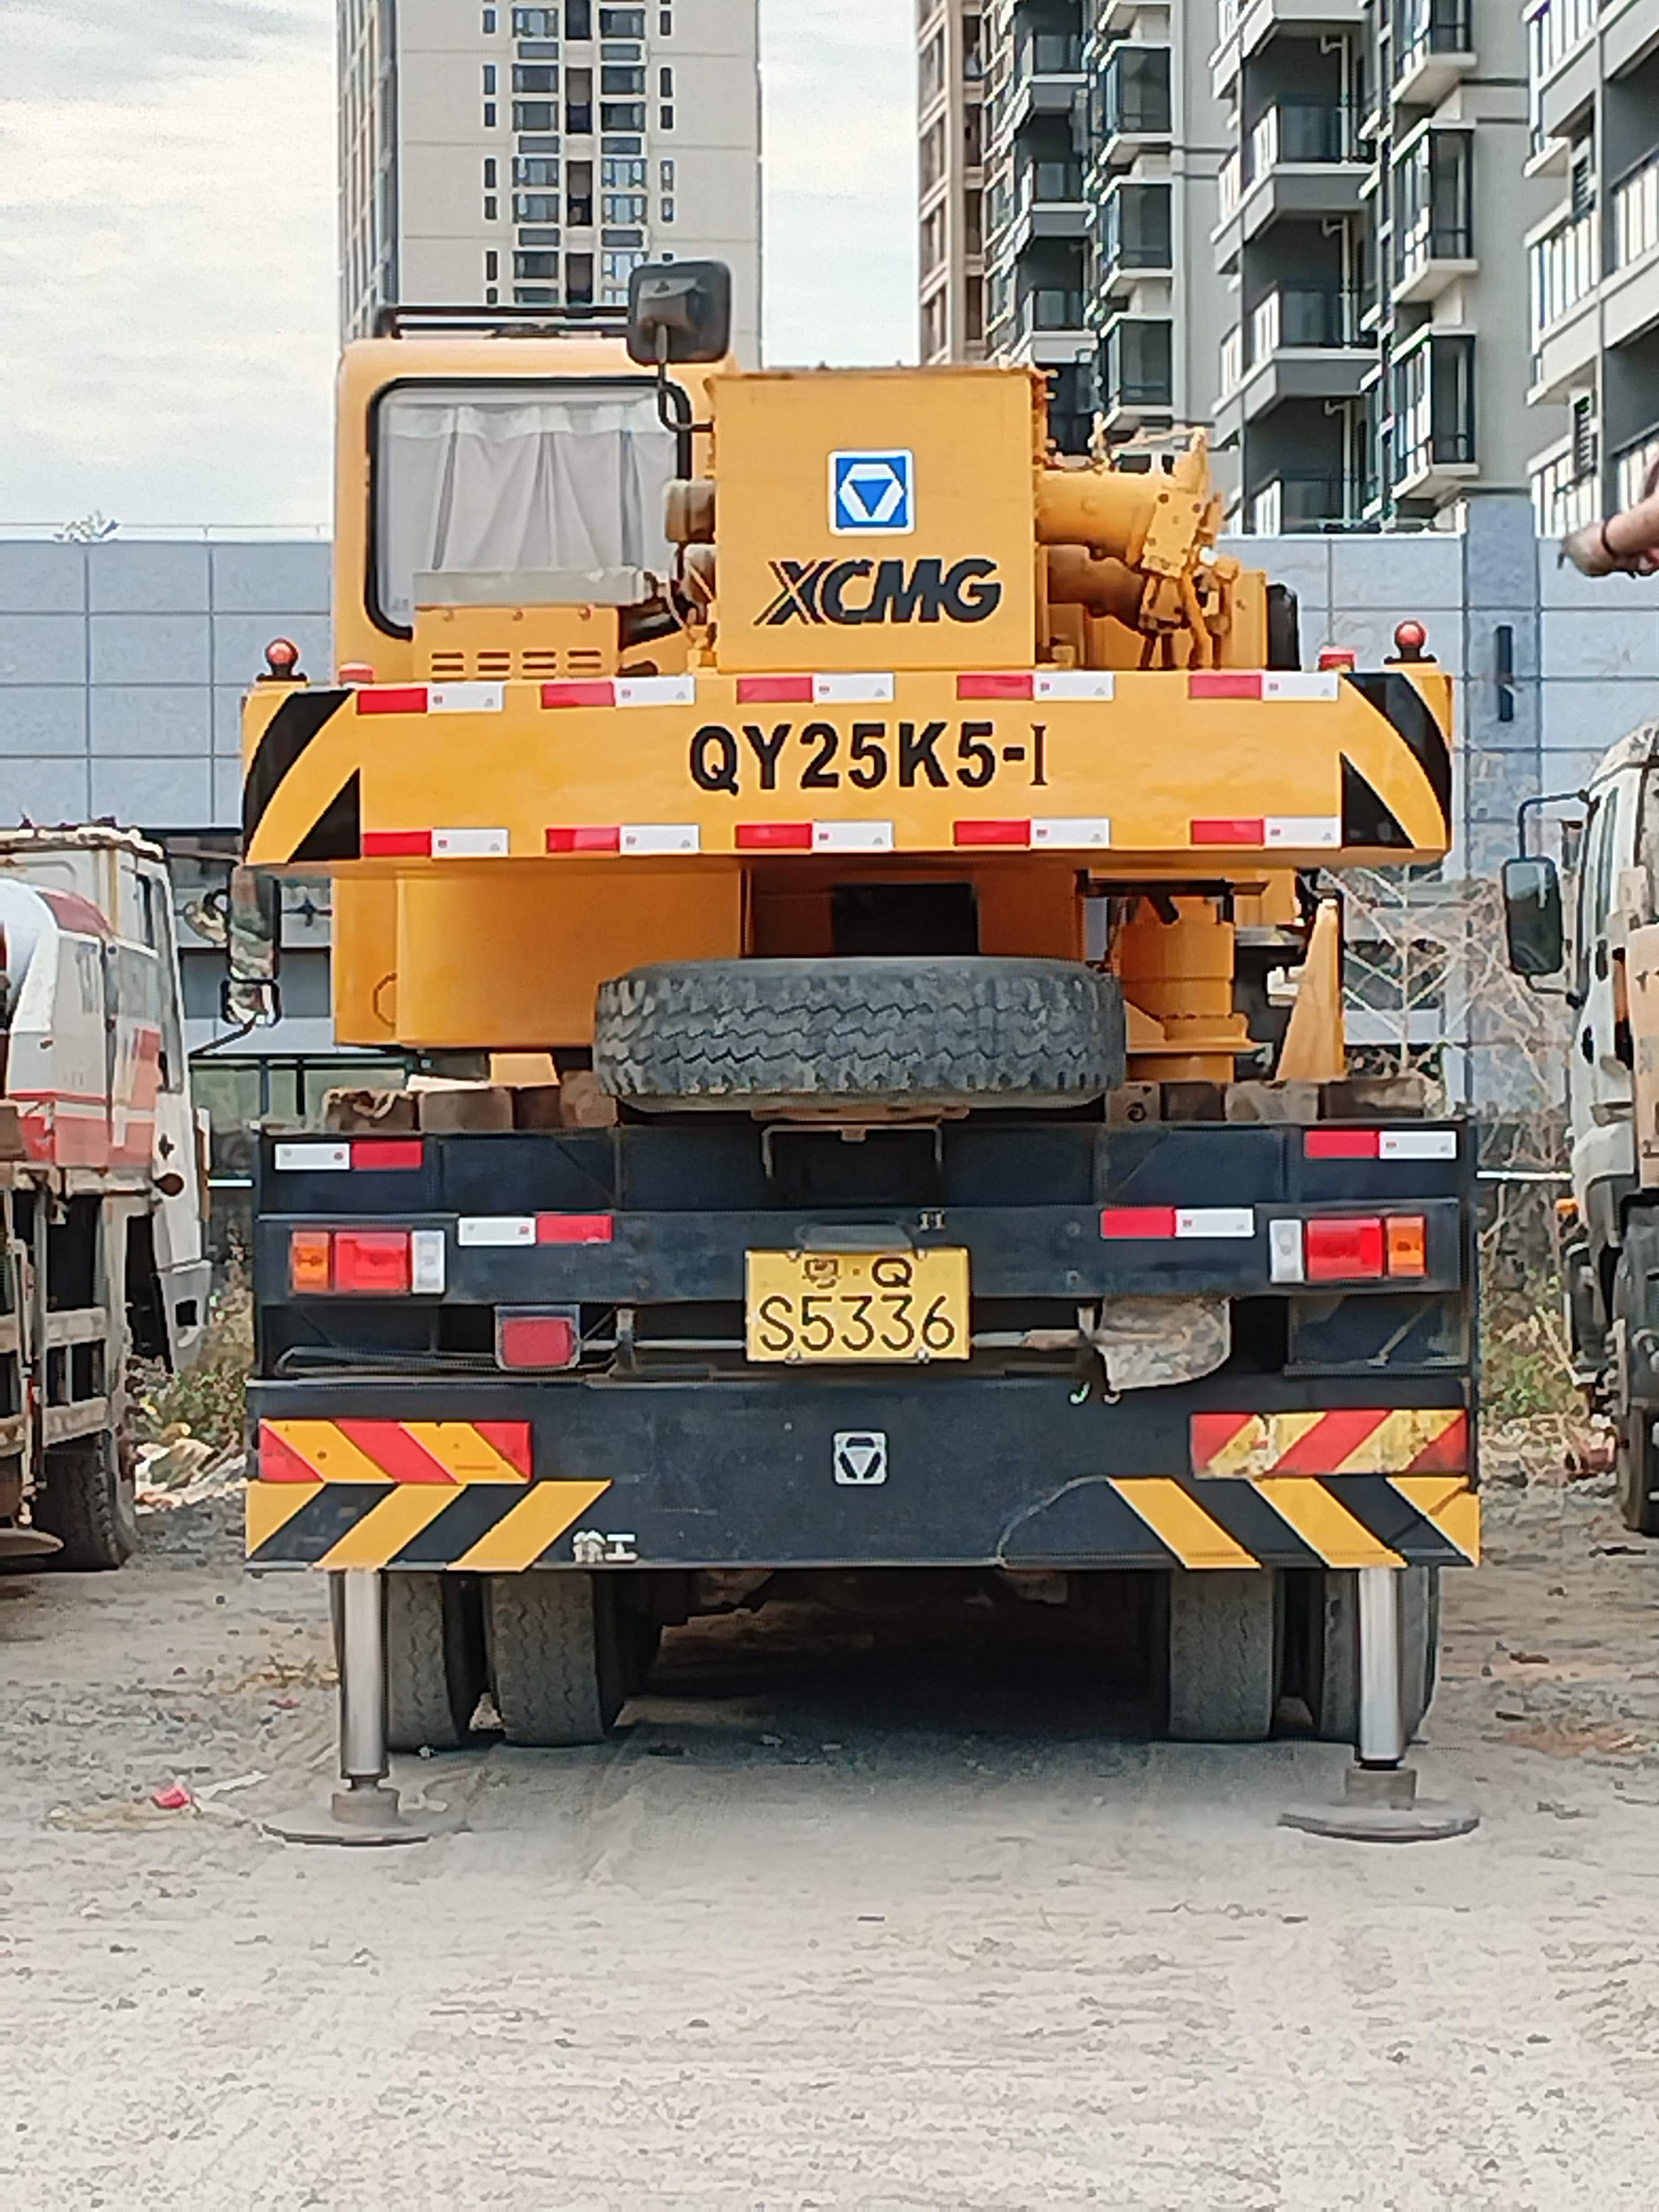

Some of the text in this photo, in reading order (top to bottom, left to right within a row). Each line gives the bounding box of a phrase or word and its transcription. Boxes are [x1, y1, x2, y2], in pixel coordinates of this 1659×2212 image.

[753, 558, 1001, 625] XCMG
[690, 721, 1048, 795] QY25K5-I
[759, 1296, 955, 1351] S5336
